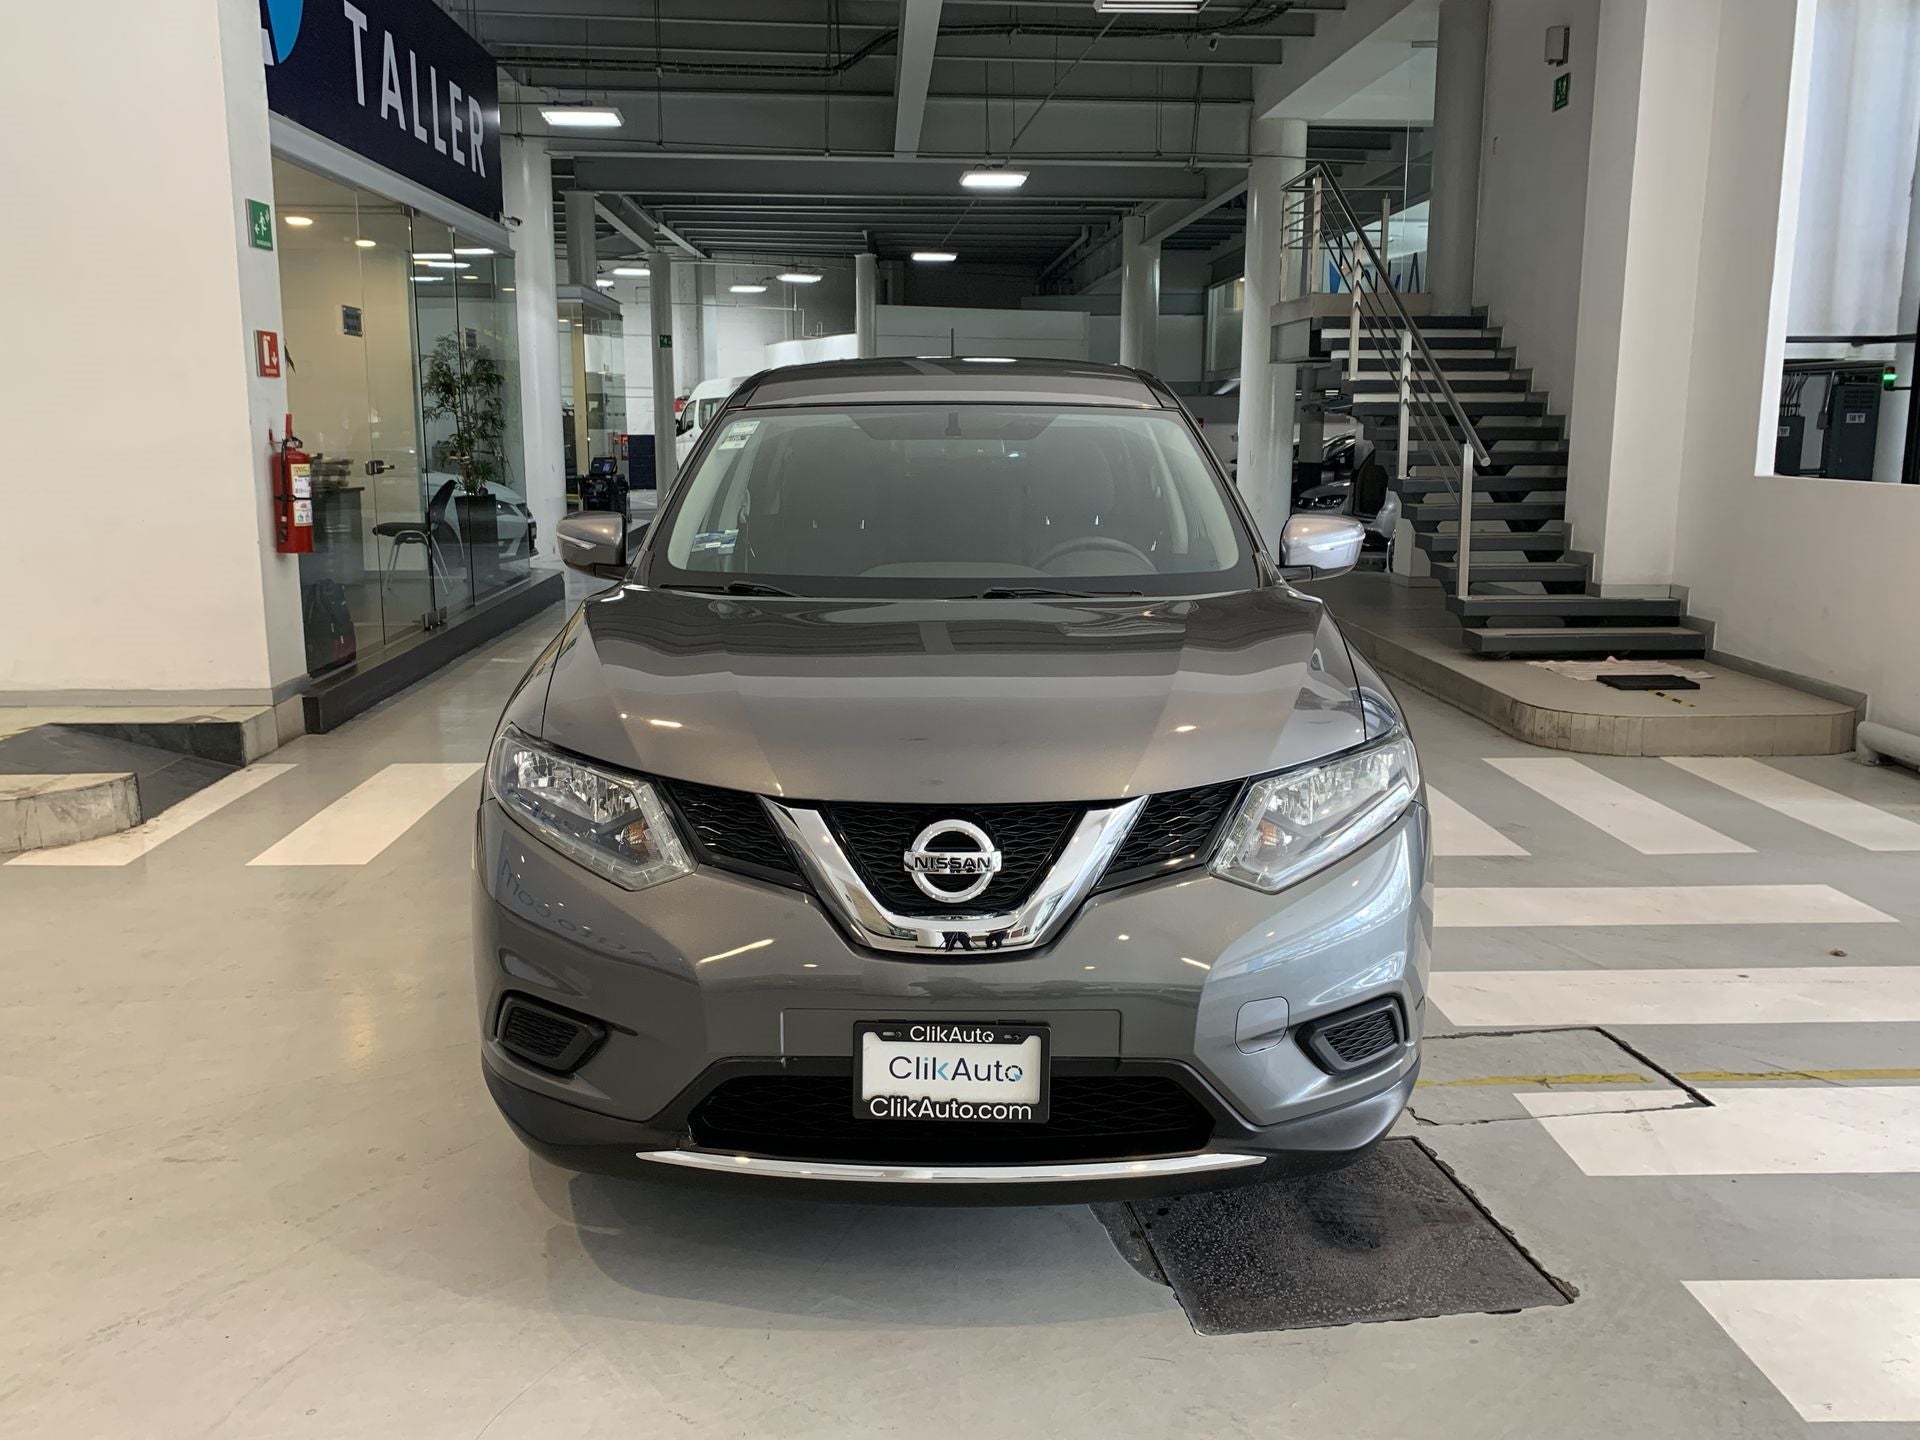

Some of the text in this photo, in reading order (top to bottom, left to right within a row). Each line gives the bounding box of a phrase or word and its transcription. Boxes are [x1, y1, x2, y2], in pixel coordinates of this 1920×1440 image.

[344, 0, 487, 178] TALLER
[914, 856, 991, 870] NISSAN
[909, 1025, 995, 1043] ClikAuto
[888, 1056, 1023, 1082] ClikAuto
[869, 1097, 1033, 1120] ClikAuto.com
